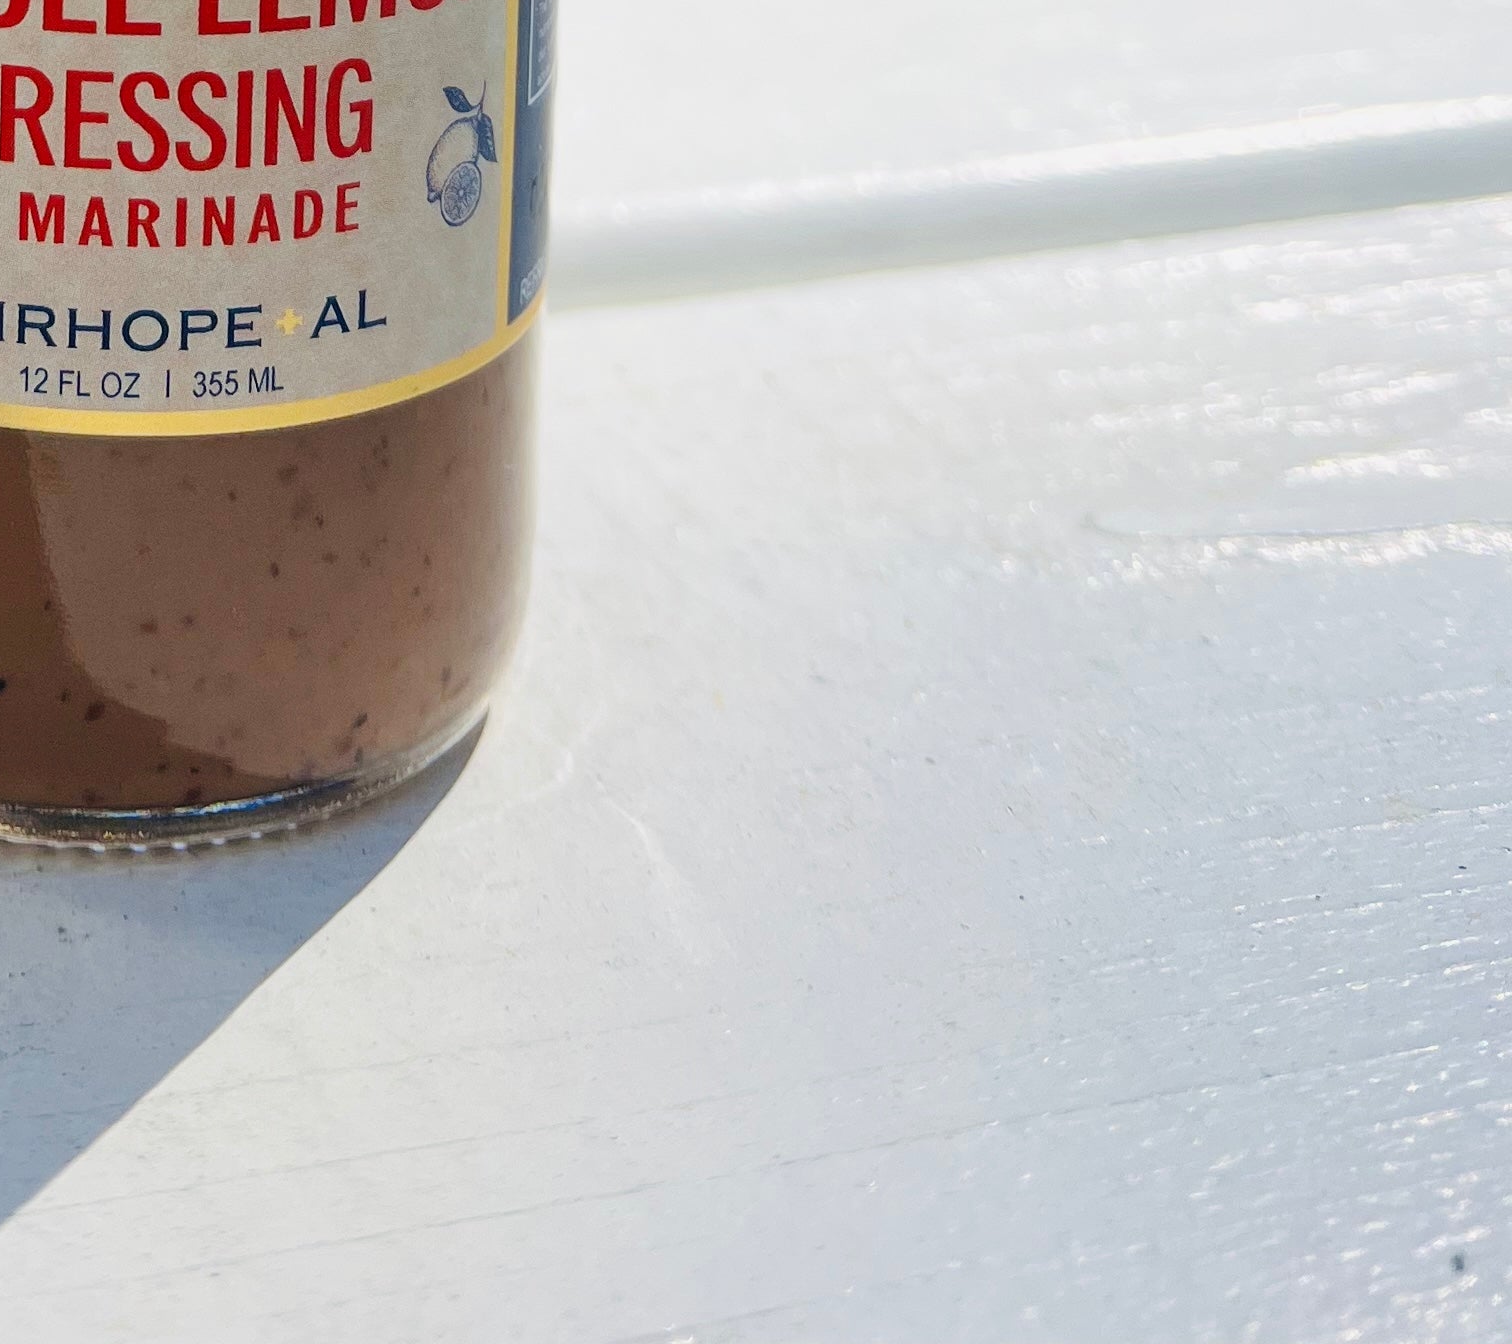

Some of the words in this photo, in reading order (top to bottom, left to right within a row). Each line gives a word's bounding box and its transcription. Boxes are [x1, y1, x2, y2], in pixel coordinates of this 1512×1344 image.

[18, 181, 362, 249] MARINADE
[308, 288, 388, 341] AL
[19, 365, 48, 396] 12
[58, 368, 91, 398] FL
[100, 371, 141, 400] OZ
[191, 369, 239, 398] 355
[247, 365, 285, 395] ML
